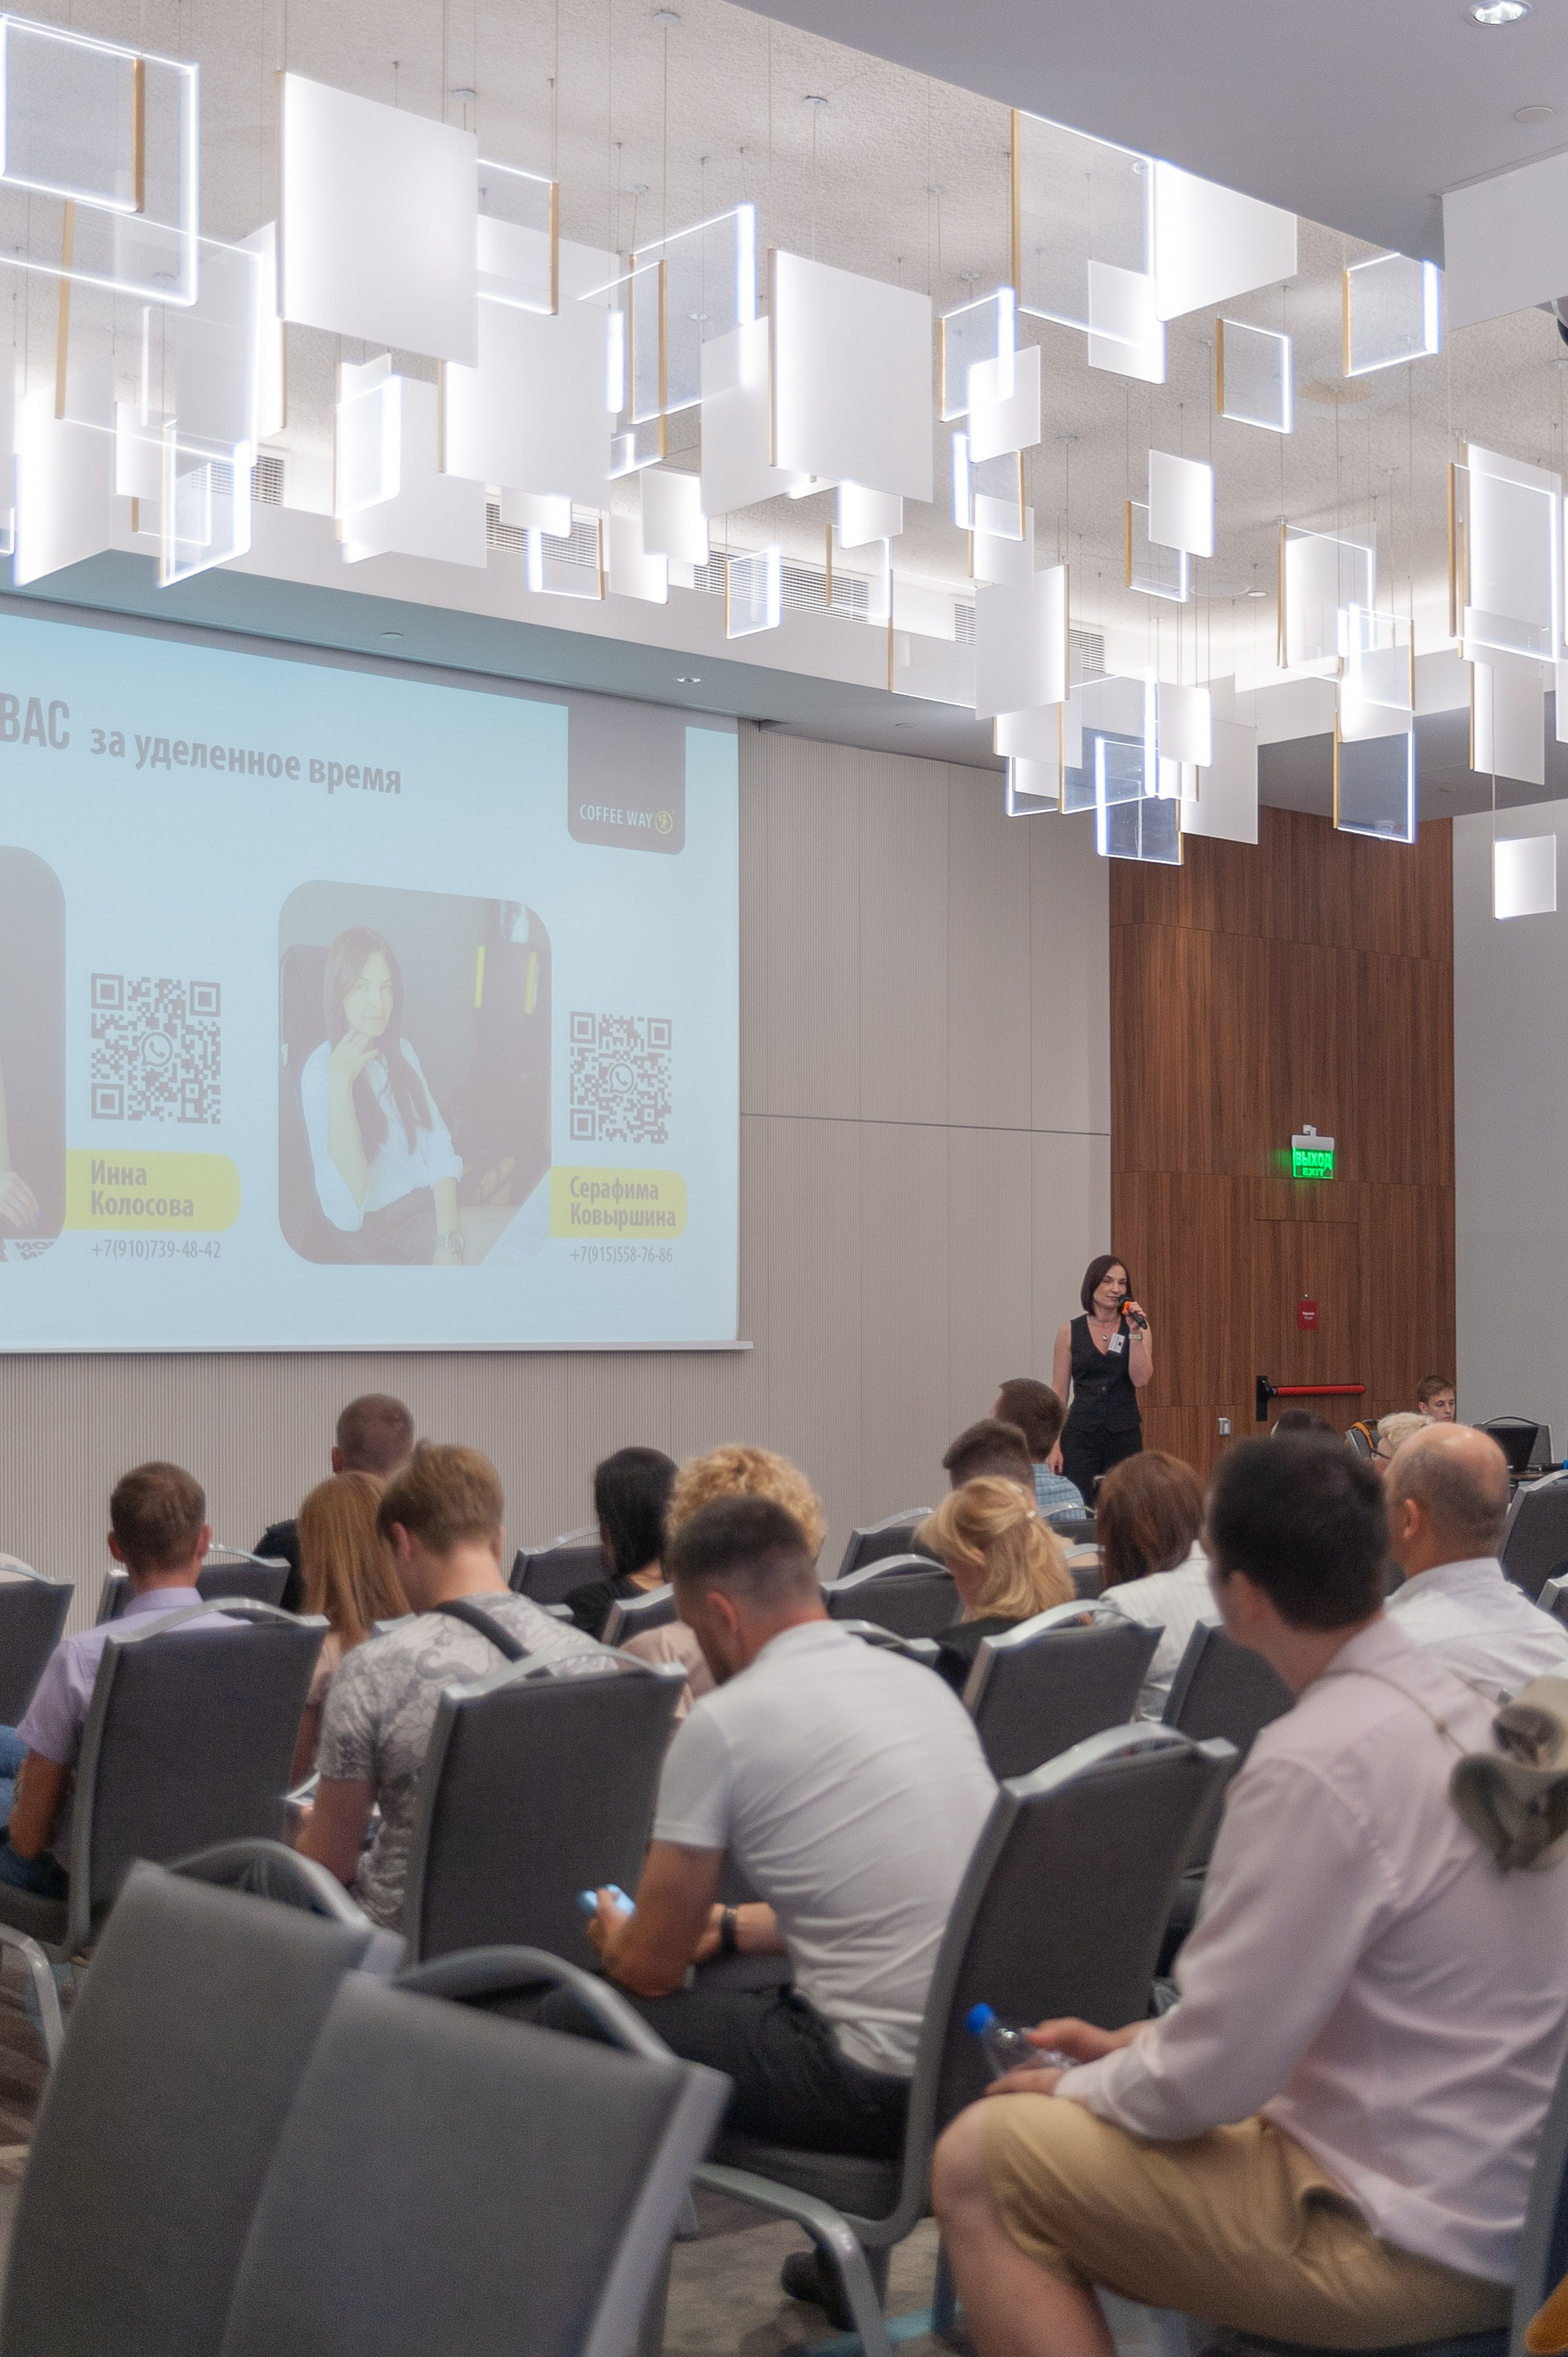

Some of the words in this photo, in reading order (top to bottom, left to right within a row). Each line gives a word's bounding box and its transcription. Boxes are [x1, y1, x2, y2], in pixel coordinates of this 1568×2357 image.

[0, 692, 70, 750] ВАС
[90, 728, 126, 758] за
[134, 734, 301, 781] уделенное
[309, 758, 401, 795] время
[579, 804, 624, 825] COFFEE
[627, 810, 653, 828] WAY
[90, 1159, 148, 1186] Инна
[1295, 1151, 1332, 1170] ВЫХОД
[1302, 1167, 1325, 1176] EXIT
[570, 1175, 659, 1205] Серафима
[90, 1190, 194, 1217] Колосова
[570, 1203, 676, 1231] Ковыршина
[91, 1239, 222, 1260] +7(910)739-48-42
[570, 1245, 673, 1264] +7(915)558-76-86
